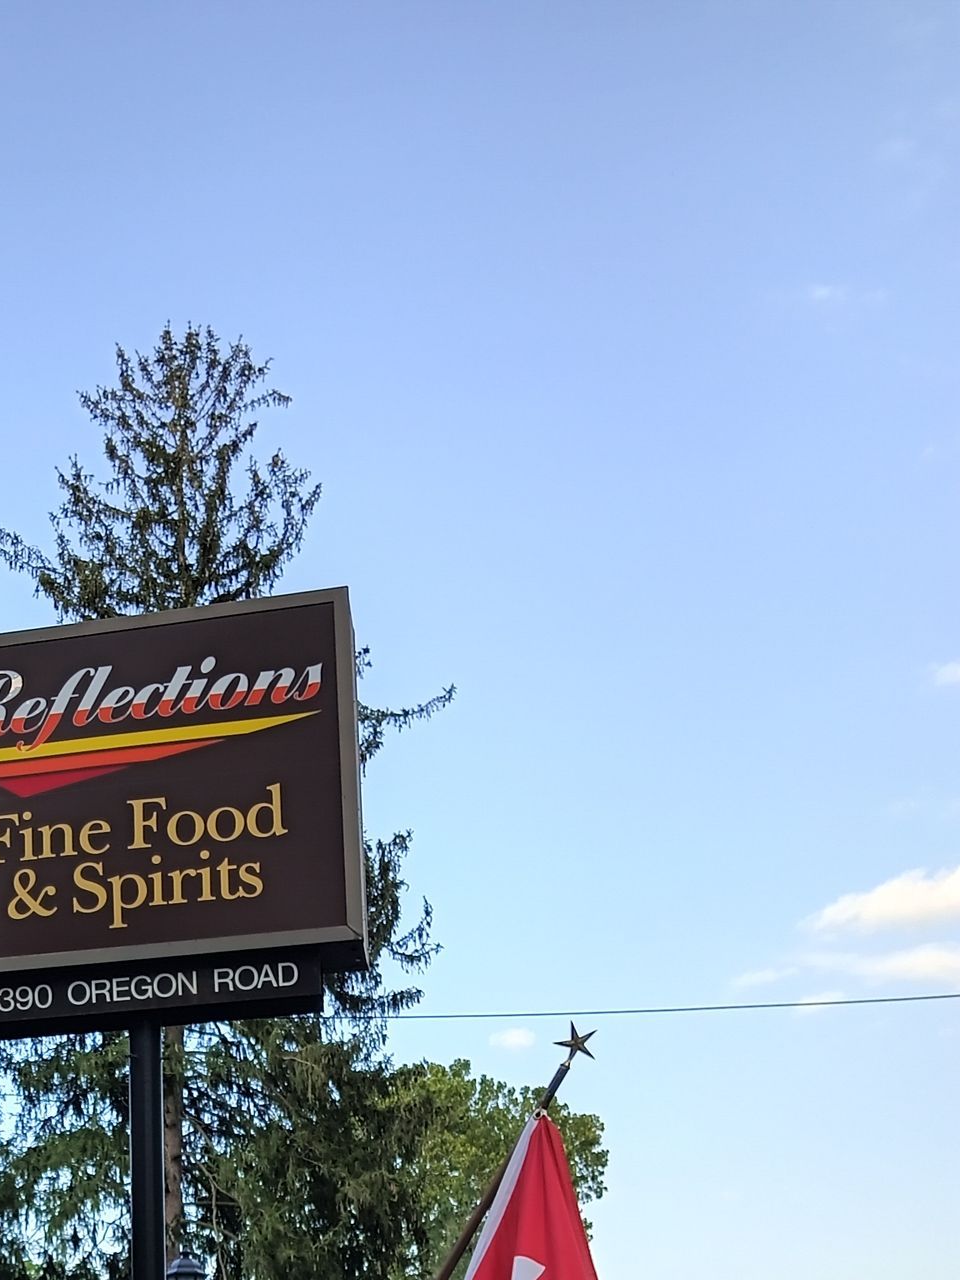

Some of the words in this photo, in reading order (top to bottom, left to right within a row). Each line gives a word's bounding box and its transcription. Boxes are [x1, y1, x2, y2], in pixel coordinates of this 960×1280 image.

[126, 783, 288, 850] Food
[7, 868, 58, 920] &
[73, 850, 264, 929] Spirits
[67, 970, 197, 1006] OREGON
[214, 962, 298, 992] ROAD
